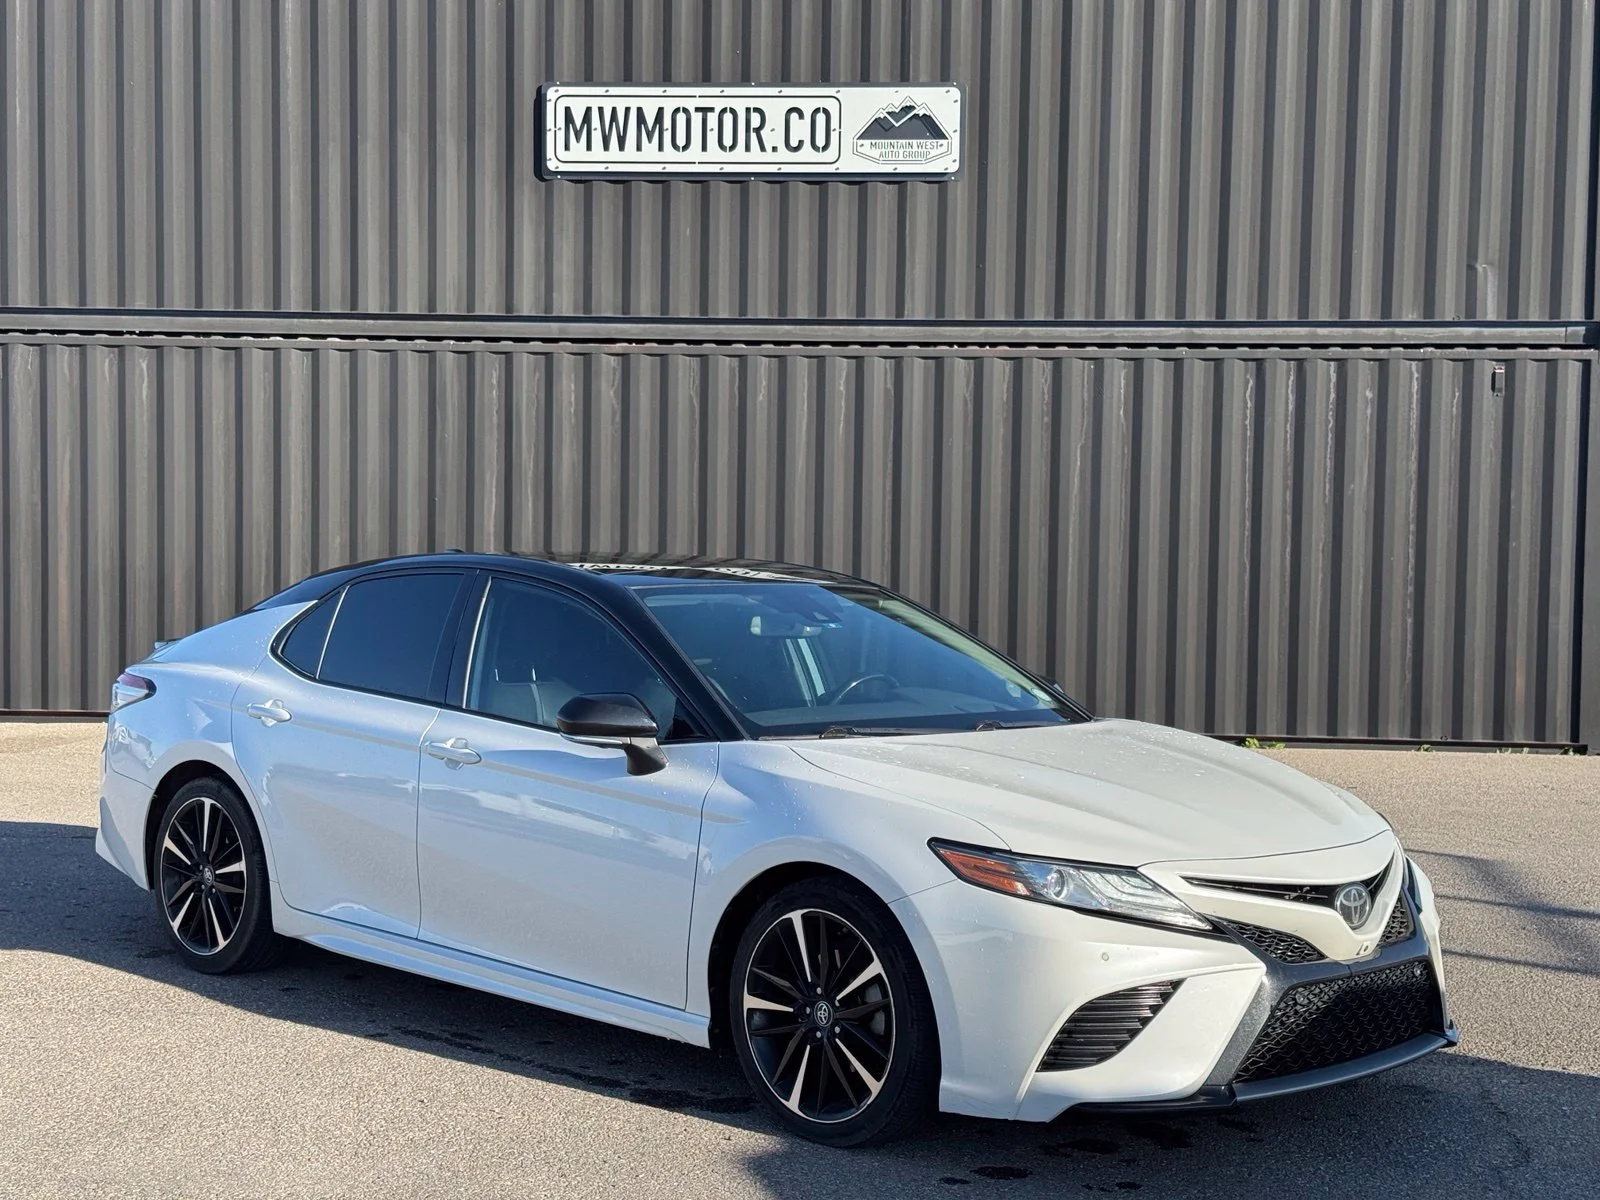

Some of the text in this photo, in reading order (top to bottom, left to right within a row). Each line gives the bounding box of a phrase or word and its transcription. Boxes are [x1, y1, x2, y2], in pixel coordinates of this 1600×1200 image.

[564, 106, 832, 153] MWMOTOR.CO
[869, 141, 940, 150] MOUNTAIN WEST
[879, 150, 931, 159] AUTO GROUP
